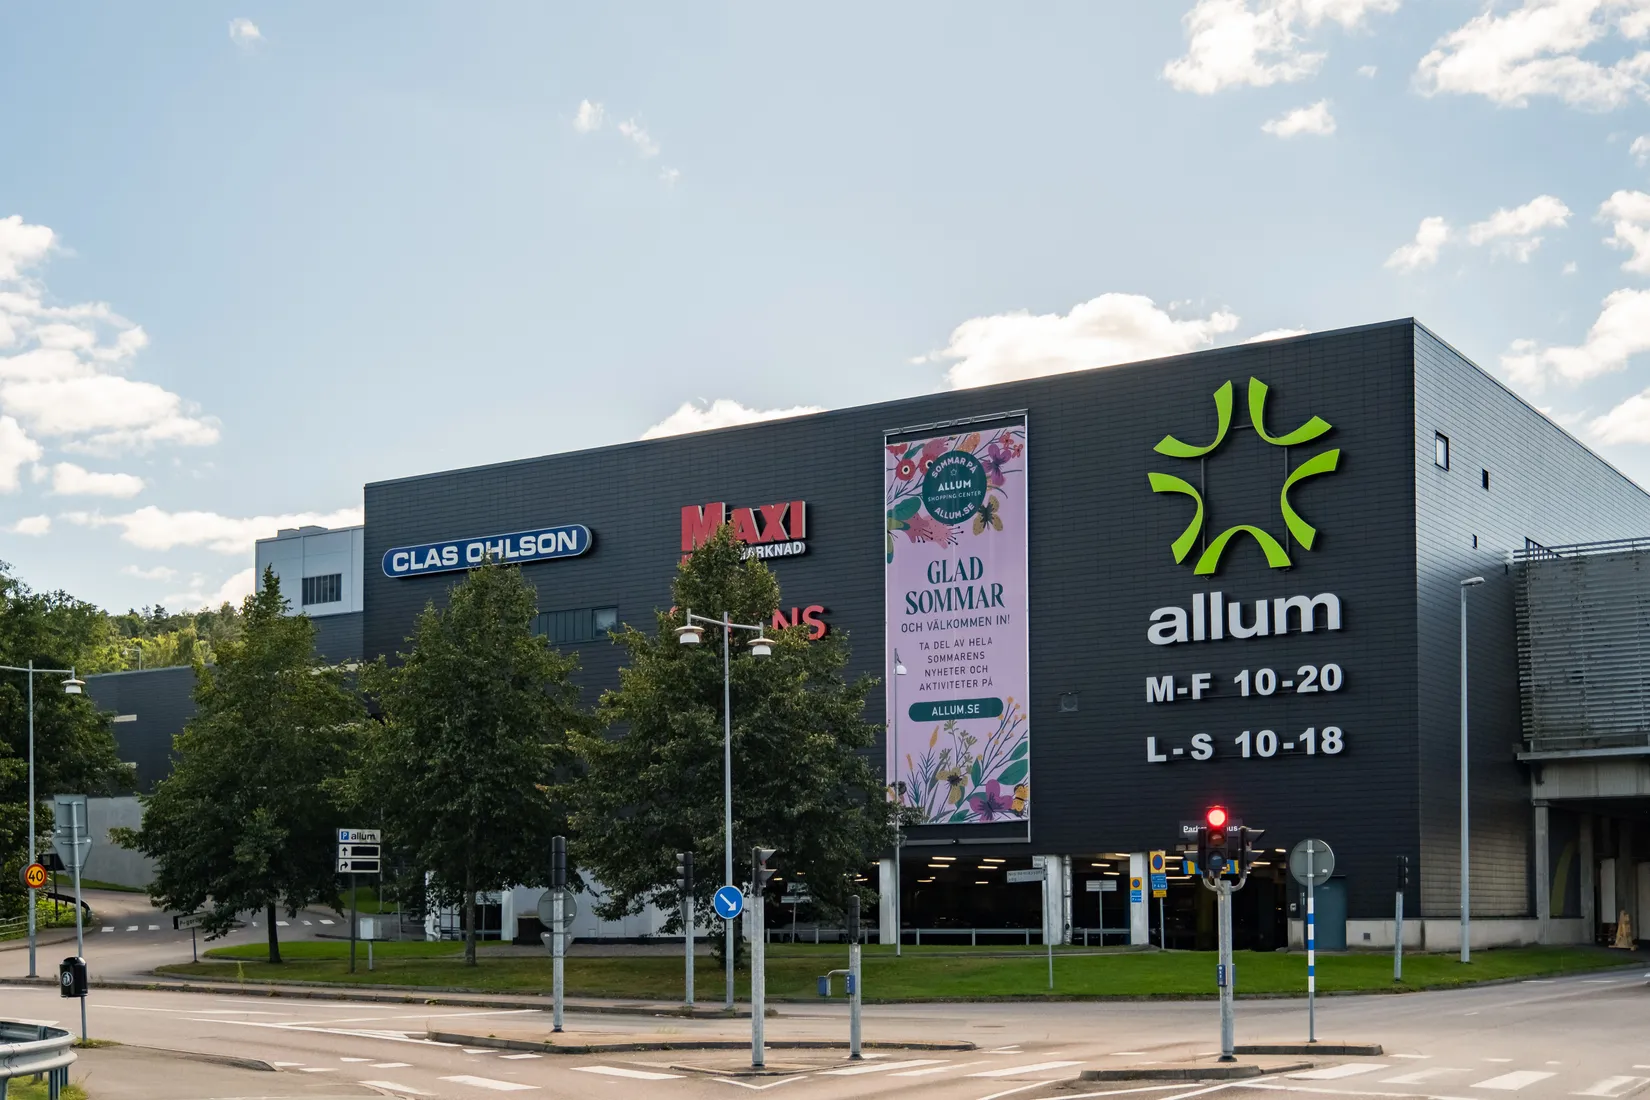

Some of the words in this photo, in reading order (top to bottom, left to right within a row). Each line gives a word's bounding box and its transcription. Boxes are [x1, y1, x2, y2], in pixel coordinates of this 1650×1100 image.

[931, 456, 966, 479] SOMMAR
[965, 461, 978, 475] PÅ
[937, 479, 972, 492] ALLUM
[927, 493, 957, 502] SHOPPING
[958, 490, 982, 499] CENTER
[934, 502, 975, 519] ALLUM.SE
[681, 499, 806, 552] MAXI
[392, 545, 459, 572] CLAS
[466, 529, 577, 563] OHLSON
[927, 556, 984, 585] GLAD
[905, 582, 1005, 615] SOMMAR
[901, 622, 923, 633] OCH
[926, 615, 992, 631] VÄLKOMMEN
[996, 614, 1010, 626] IN!
[1147, 591, 1341, 645] allum
[919, 641, 930, 651] TA
[933, 640, 950, 650] DEL
[953, 639, 965, 648] AV
[968, 636, 993, 647] HELA
[927, 651, 985, 664] SOMMARENS
[924, 666, 966, 677] NYHETER
[969, 665, 988, 674] OCH
[919, 679, 978, 691] AKTIVITETER
[981, 676, 993, 687] PÅ
[1146, 672, 1211, 702] M-F
[1234, 663, 1343, 697] 10-20
[931, 704, 980, 716] ALLUM.SE
[1147, 733, 1214, 763] L-S
[1234, 726, 1344, 758] 10-18
[351, 832, 376, 840] allum
[28, 870, 44, 882] 40
